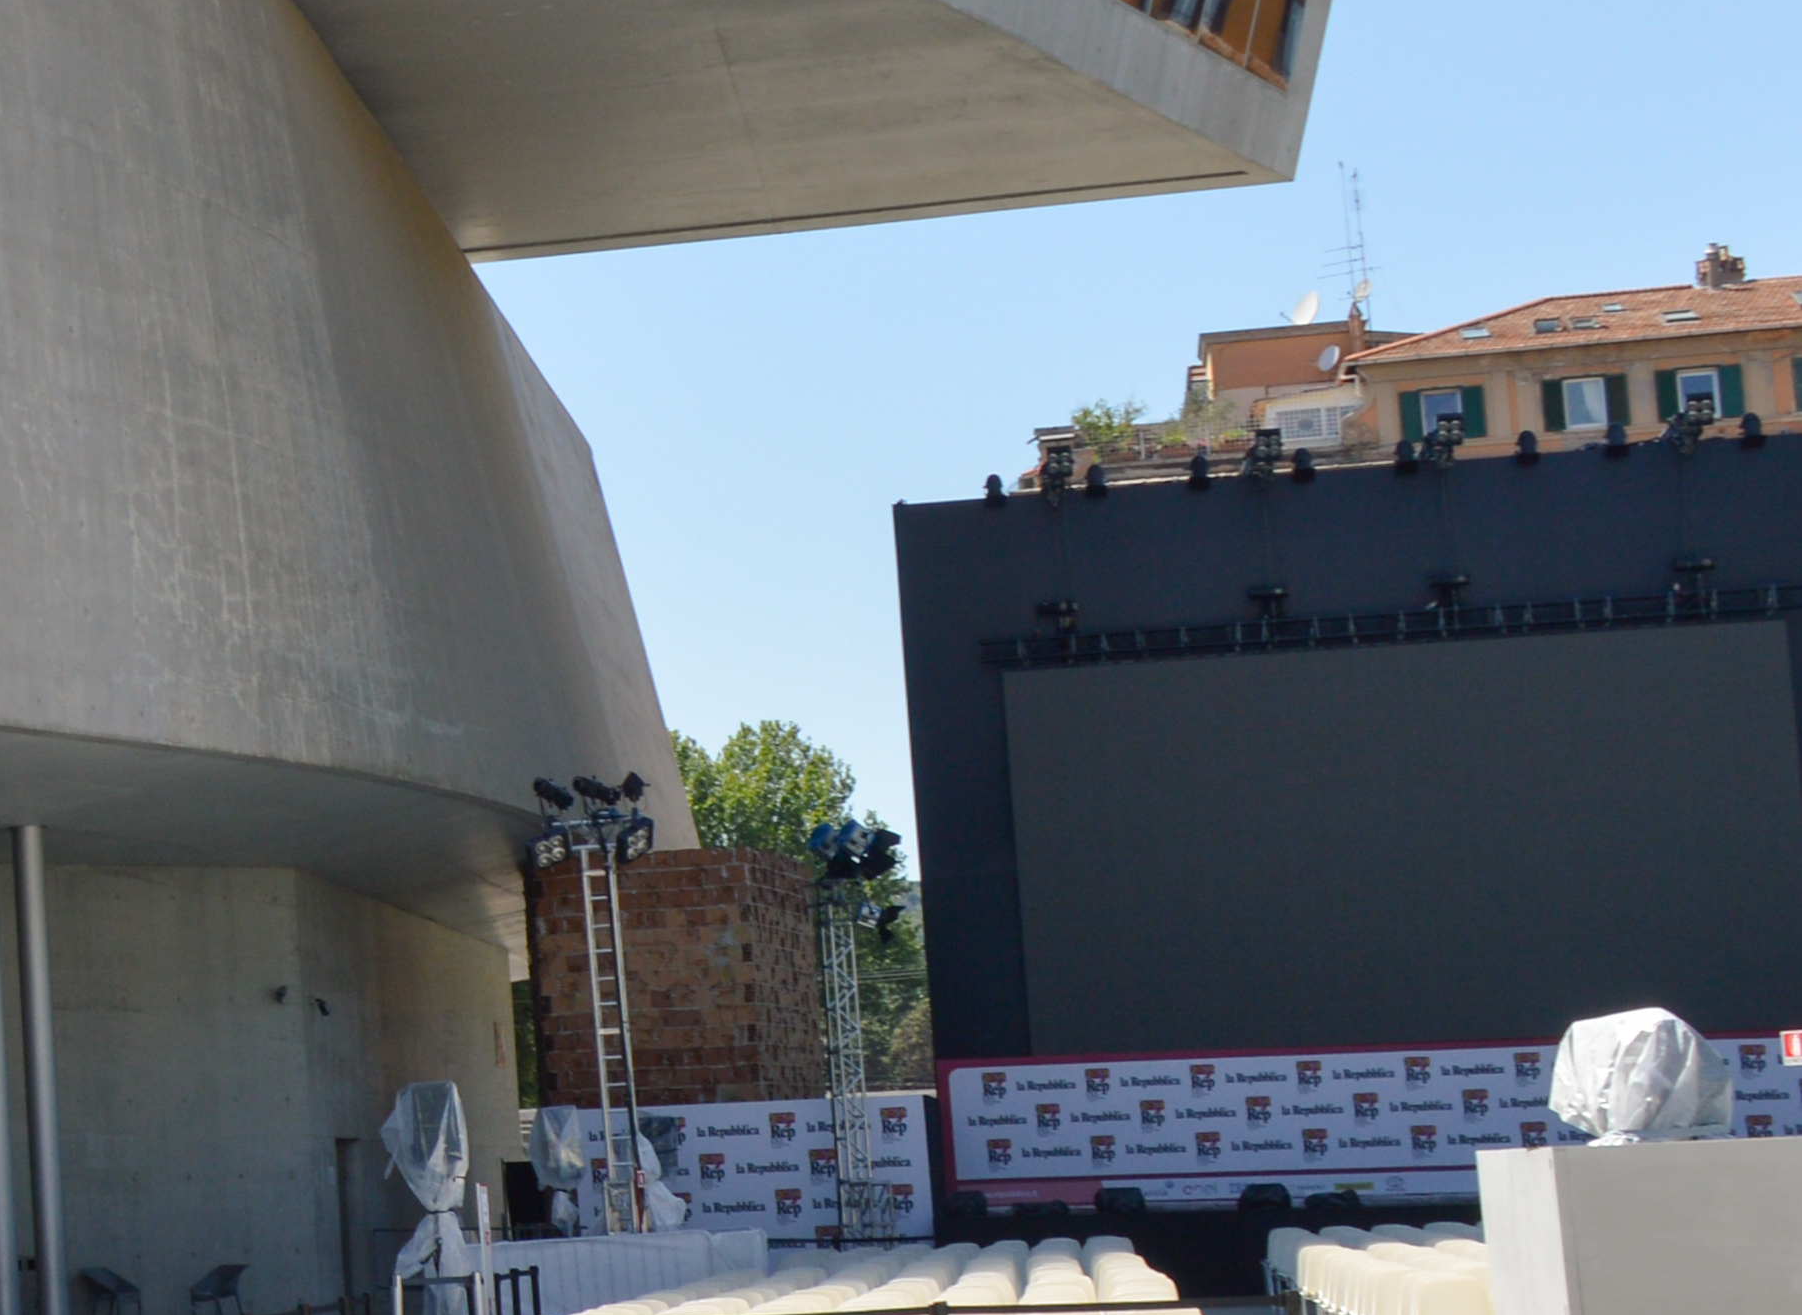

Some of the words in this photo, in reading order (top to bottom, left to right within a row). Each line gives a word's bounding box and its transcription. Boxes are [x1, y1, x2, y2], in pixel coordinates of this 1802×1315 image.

[1332, 1070, 1341, 1080] la
[1343, 1068, 1395, 1081] Repubblica
[1441, 1066, 1450, 1076] la
[1452, 1064, 1504, 1077] Repubblica
[1120, 1077, 1129, 1087] la
[1131, 1075, 1180, 1088] Repubblica
[1225, 1073, 1234, 1083] la
[1236, 1072, 1287, 1084] Repubblica
[1016, 1081, 1025, 1091] la
[1027, 1080, 1076, 1092] Repubblica
[1175, 1109, 1184, 1119] la
[1186, 1107, 1236, 1120] Repubblica
[1281, 1106, 1290, 1116] la
[1292, 1104, 1344, 1117] Repubblica
[1389, 1102, 1398, 1112] la
[1400, 1101, 1452, 1113] Repubblica
[967, 1116, 976, 1126] la
[978, 1115, 1027, 1127] Repubblica
[1070, 1113, 1079, 1123] la
[1081, 1111, 1131, 1124] Repubblica
[697, 1126, 705, 1136] la
[708, 1123, 760, 1137] Repubblica
[1231, 1141, 1240, 1151] la
[1242, 1140, 1292, 1152] Repubblica
[1339, 1138, 1348, 1148] la
[1350, 1137, 1401, 1149] Repubblica
[1447, 1135, 1456, 1145] la
[1459, 1133, 1511, 1146] Repubblica
[1021, 1148, 1030, 1158] la
[1032, 1147, 1081, 1159] Repubblica
[1125, 1144, 1134, 1154] la
[1136, 1143, 1186, 1156] Repubblica
[736, 1164, 744, 1174] la
[747, 1161, 799, 1175] Repubblica
[702, 1202, 711, 1212] la
[713, 1198, 765, 1216] Repubblica
